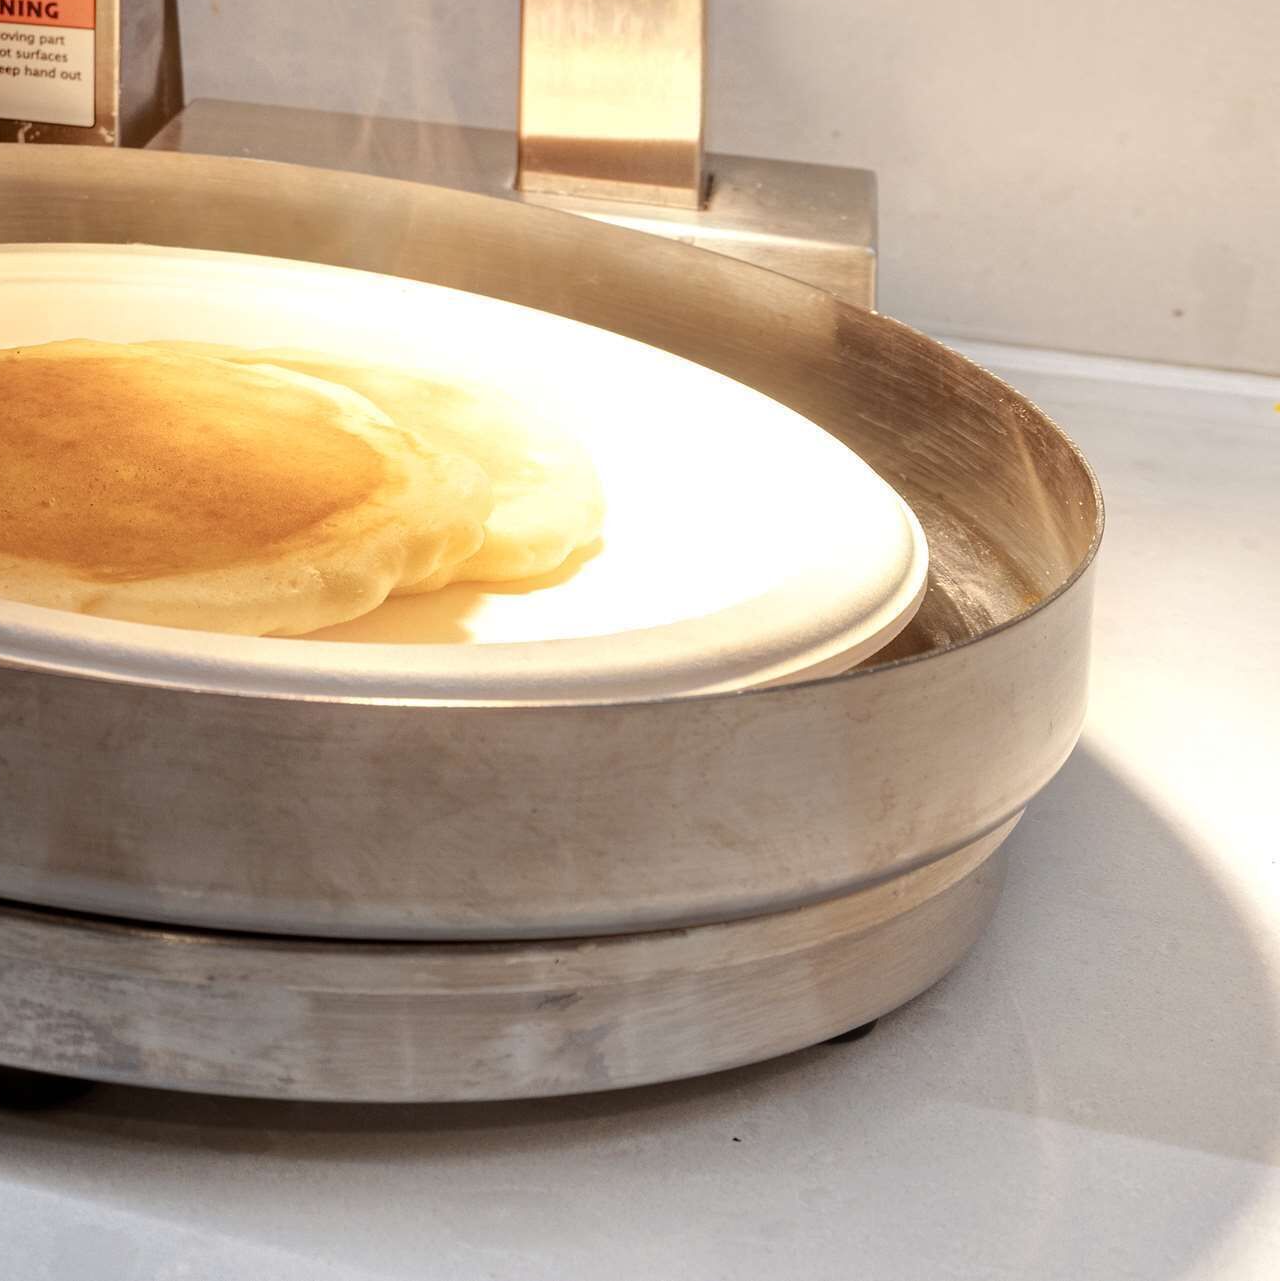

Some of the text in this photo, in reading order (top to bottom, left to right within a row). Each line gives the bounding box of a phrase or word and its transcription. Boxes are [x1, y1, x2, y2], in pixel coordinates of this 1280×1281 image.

[39, 34, 65, 47] part
[16, 48, 68, 63] surfaces
[24, 66, 56, 79] hand
[61, 71, 82, 81] out
